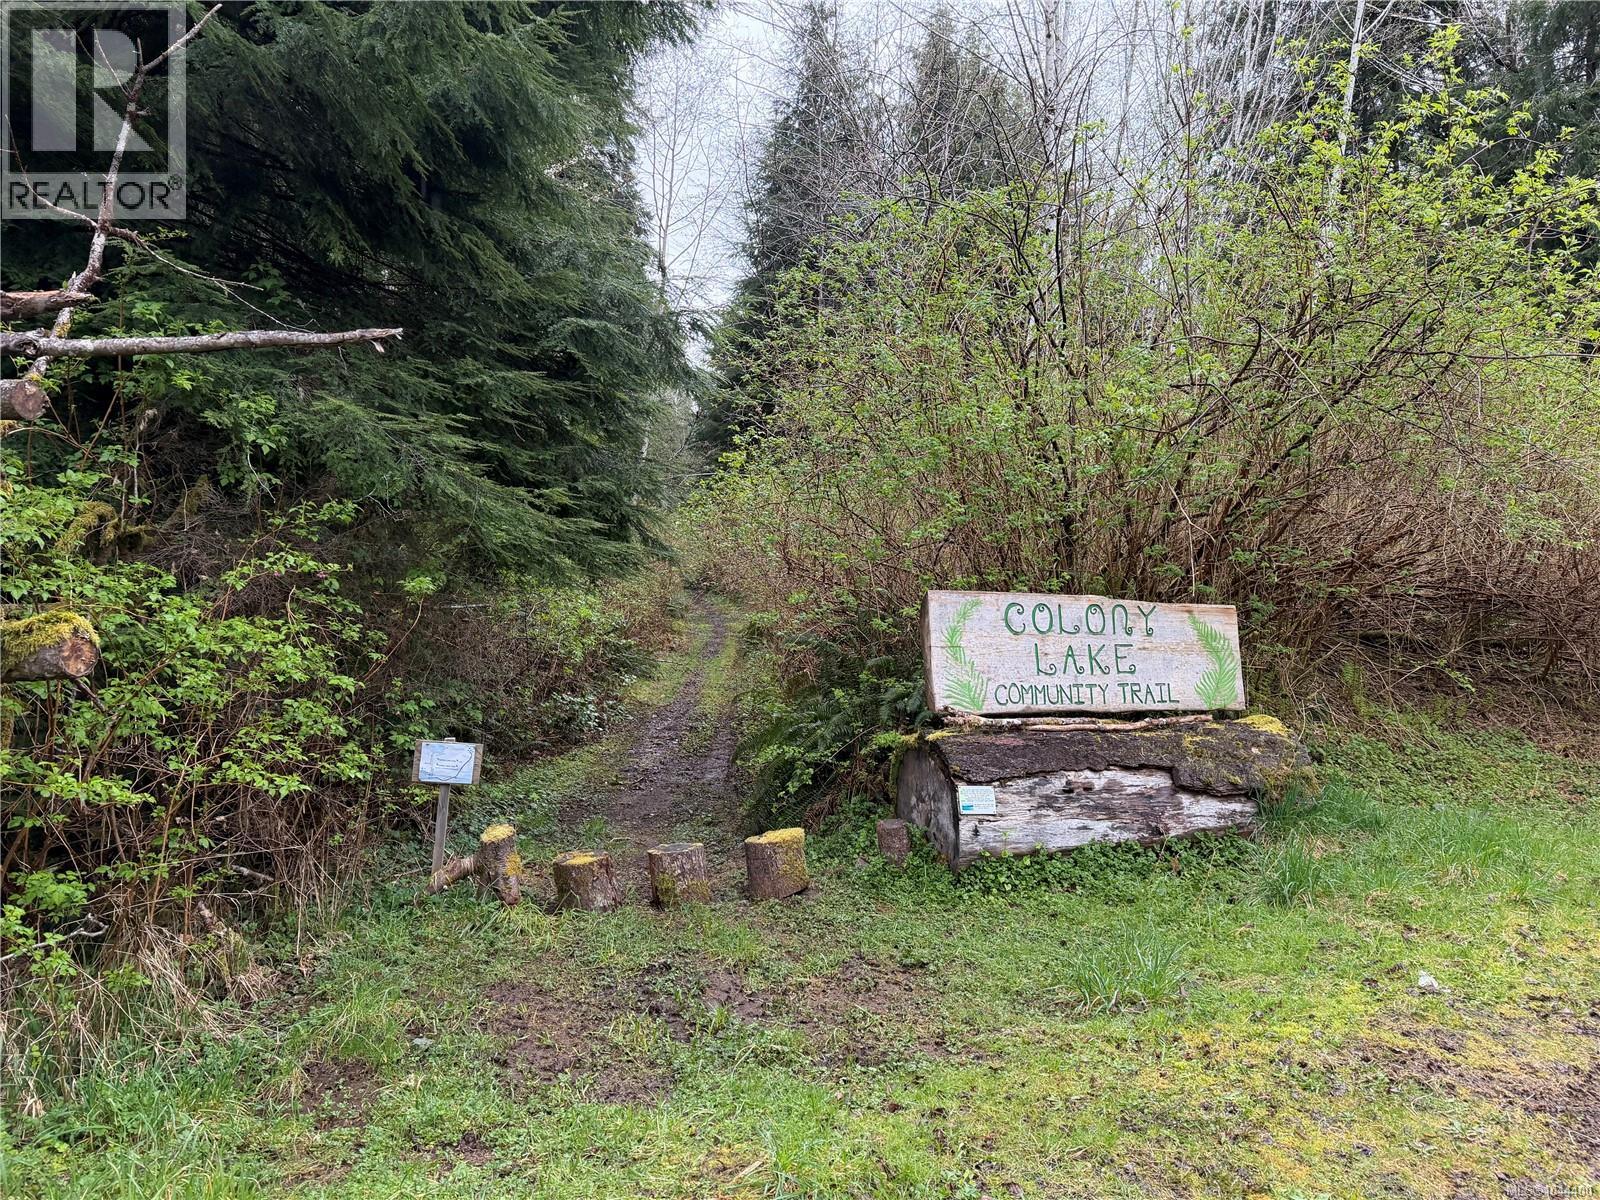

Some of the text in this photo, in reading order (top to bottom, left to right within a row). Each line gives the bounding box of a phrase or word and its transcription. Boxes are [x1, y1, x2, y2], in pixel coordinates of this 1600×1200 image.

[1004, 602, 1157, 636] COLONY
[1035, 643, 1138, 676] LAKE
[994, 682, 1180, 706] COMMUNITY TRAIL
